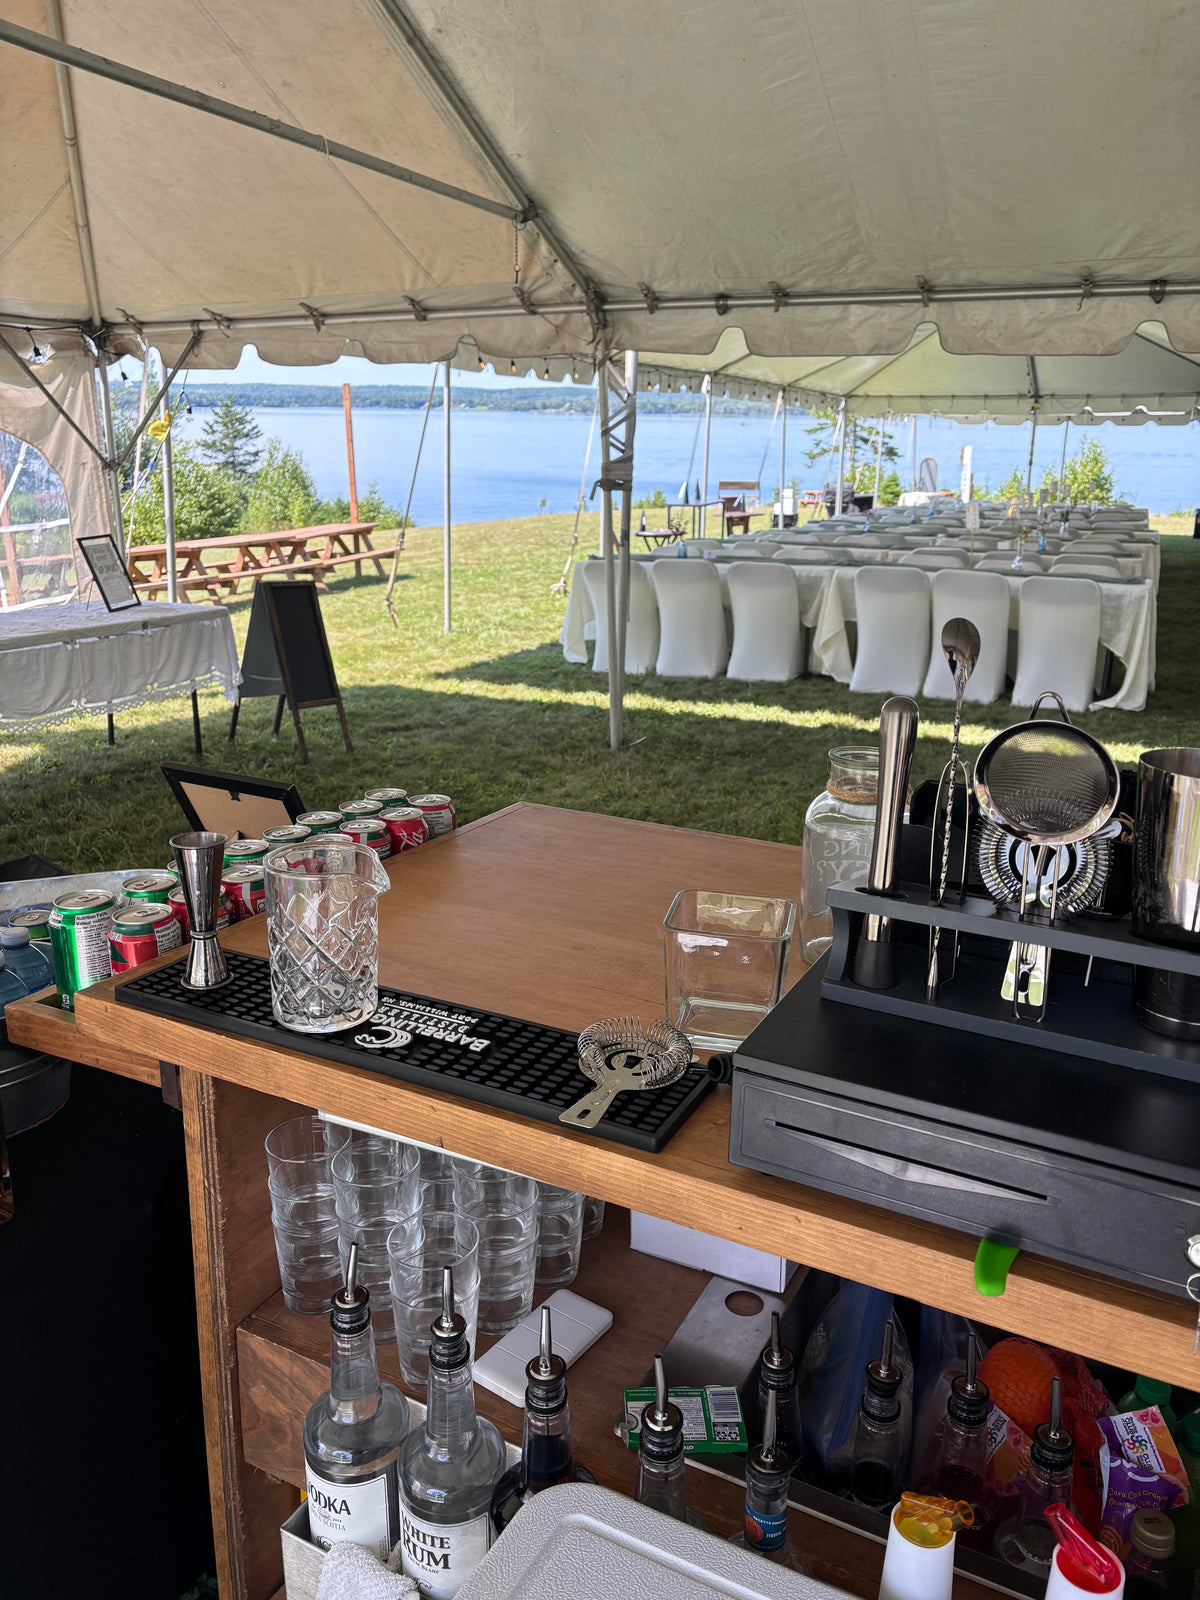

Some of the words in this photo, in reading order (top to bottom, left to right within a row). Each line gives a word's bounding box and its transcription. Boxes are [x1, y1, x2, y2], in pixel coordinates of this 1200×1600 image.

[382, 996, 397, 1004] NS
[370, 1014, 491, 1051] BARRELLING
[377, 1005, 471, 1034] DISTILLER
[451, 1011, 479, 1023] PORT
[401, 1510, 451, 1549] WHITE
[403, 1527, 452, 1570] RUM
